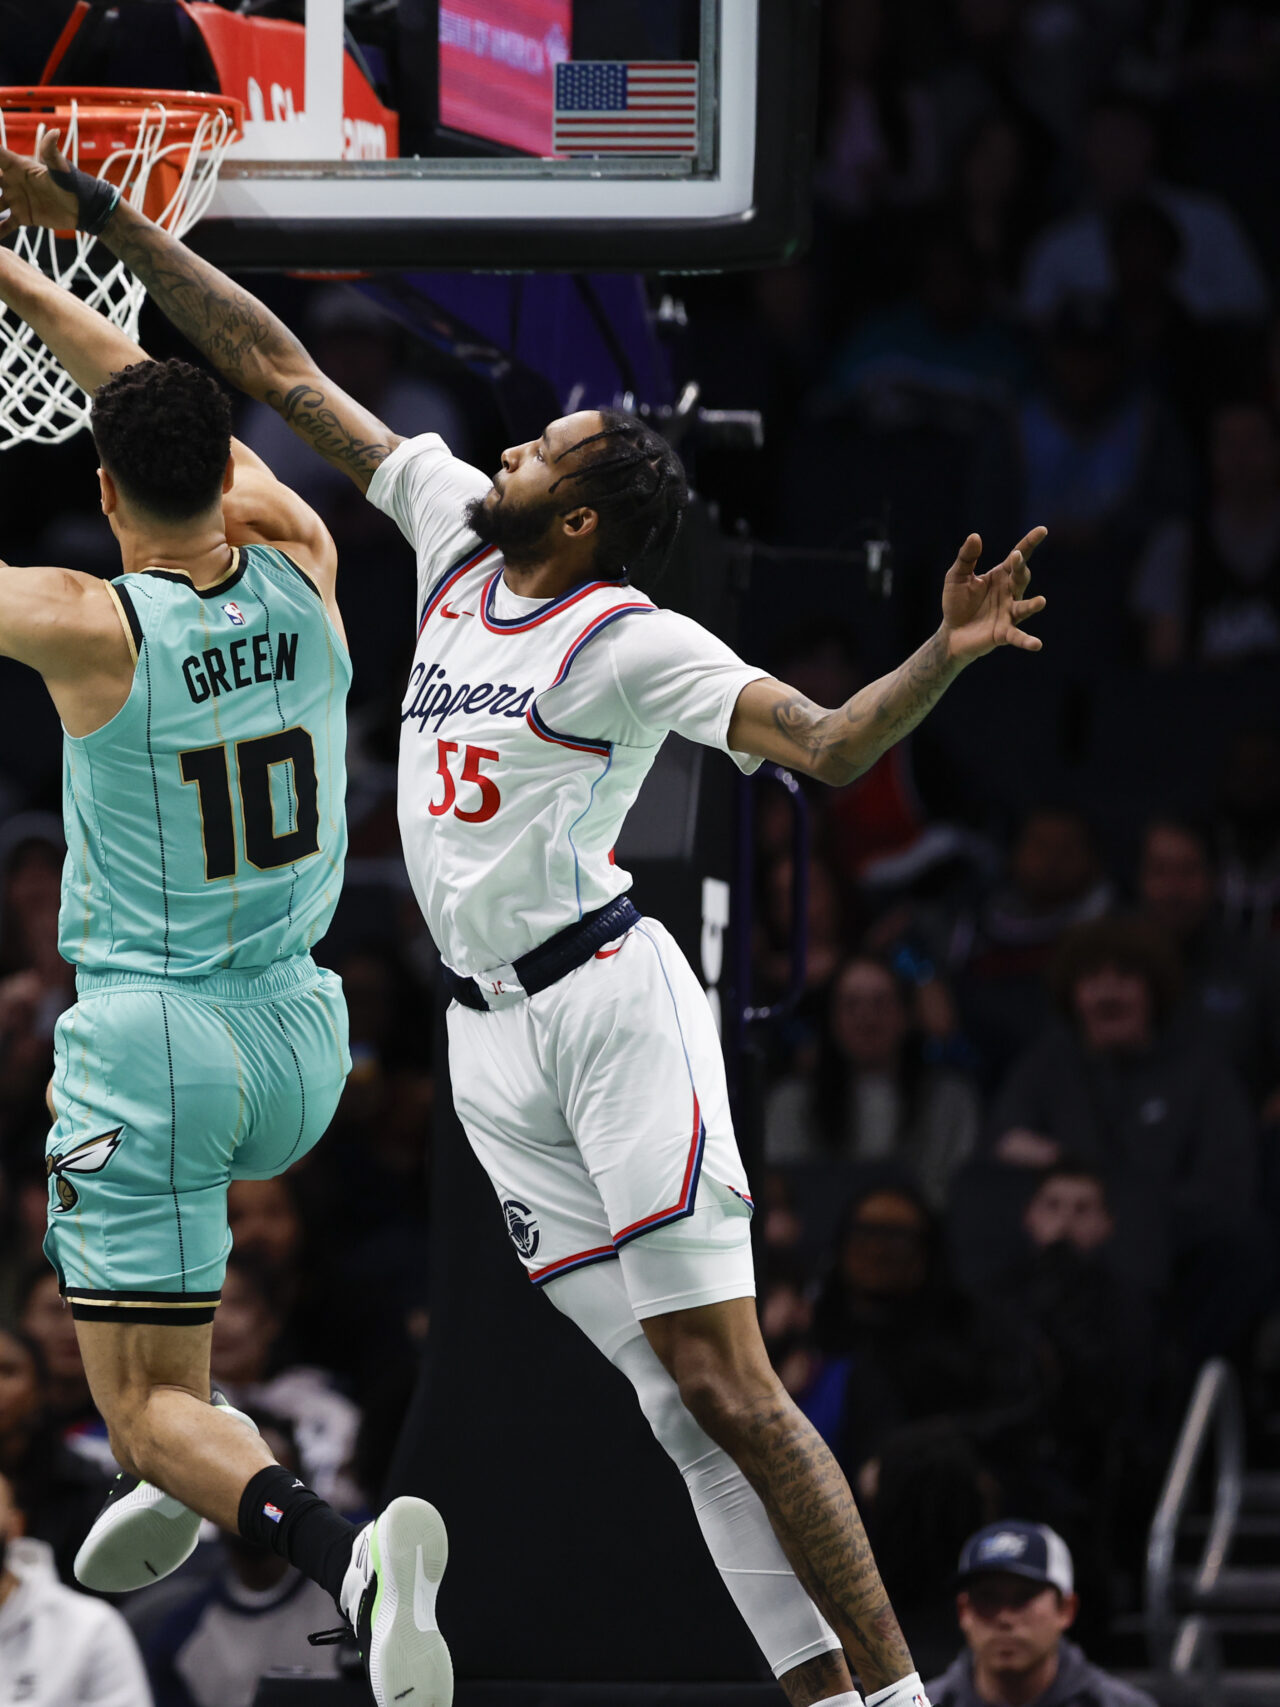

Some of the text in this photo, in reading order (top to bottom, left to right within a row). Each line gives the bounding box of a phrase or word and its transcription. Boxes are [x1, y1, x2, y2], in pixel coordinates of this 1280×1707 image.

[182, 632, 299, 704] GREEN
[178, 724, 322, 883] 10
[428, 738, 501, 823] 55
